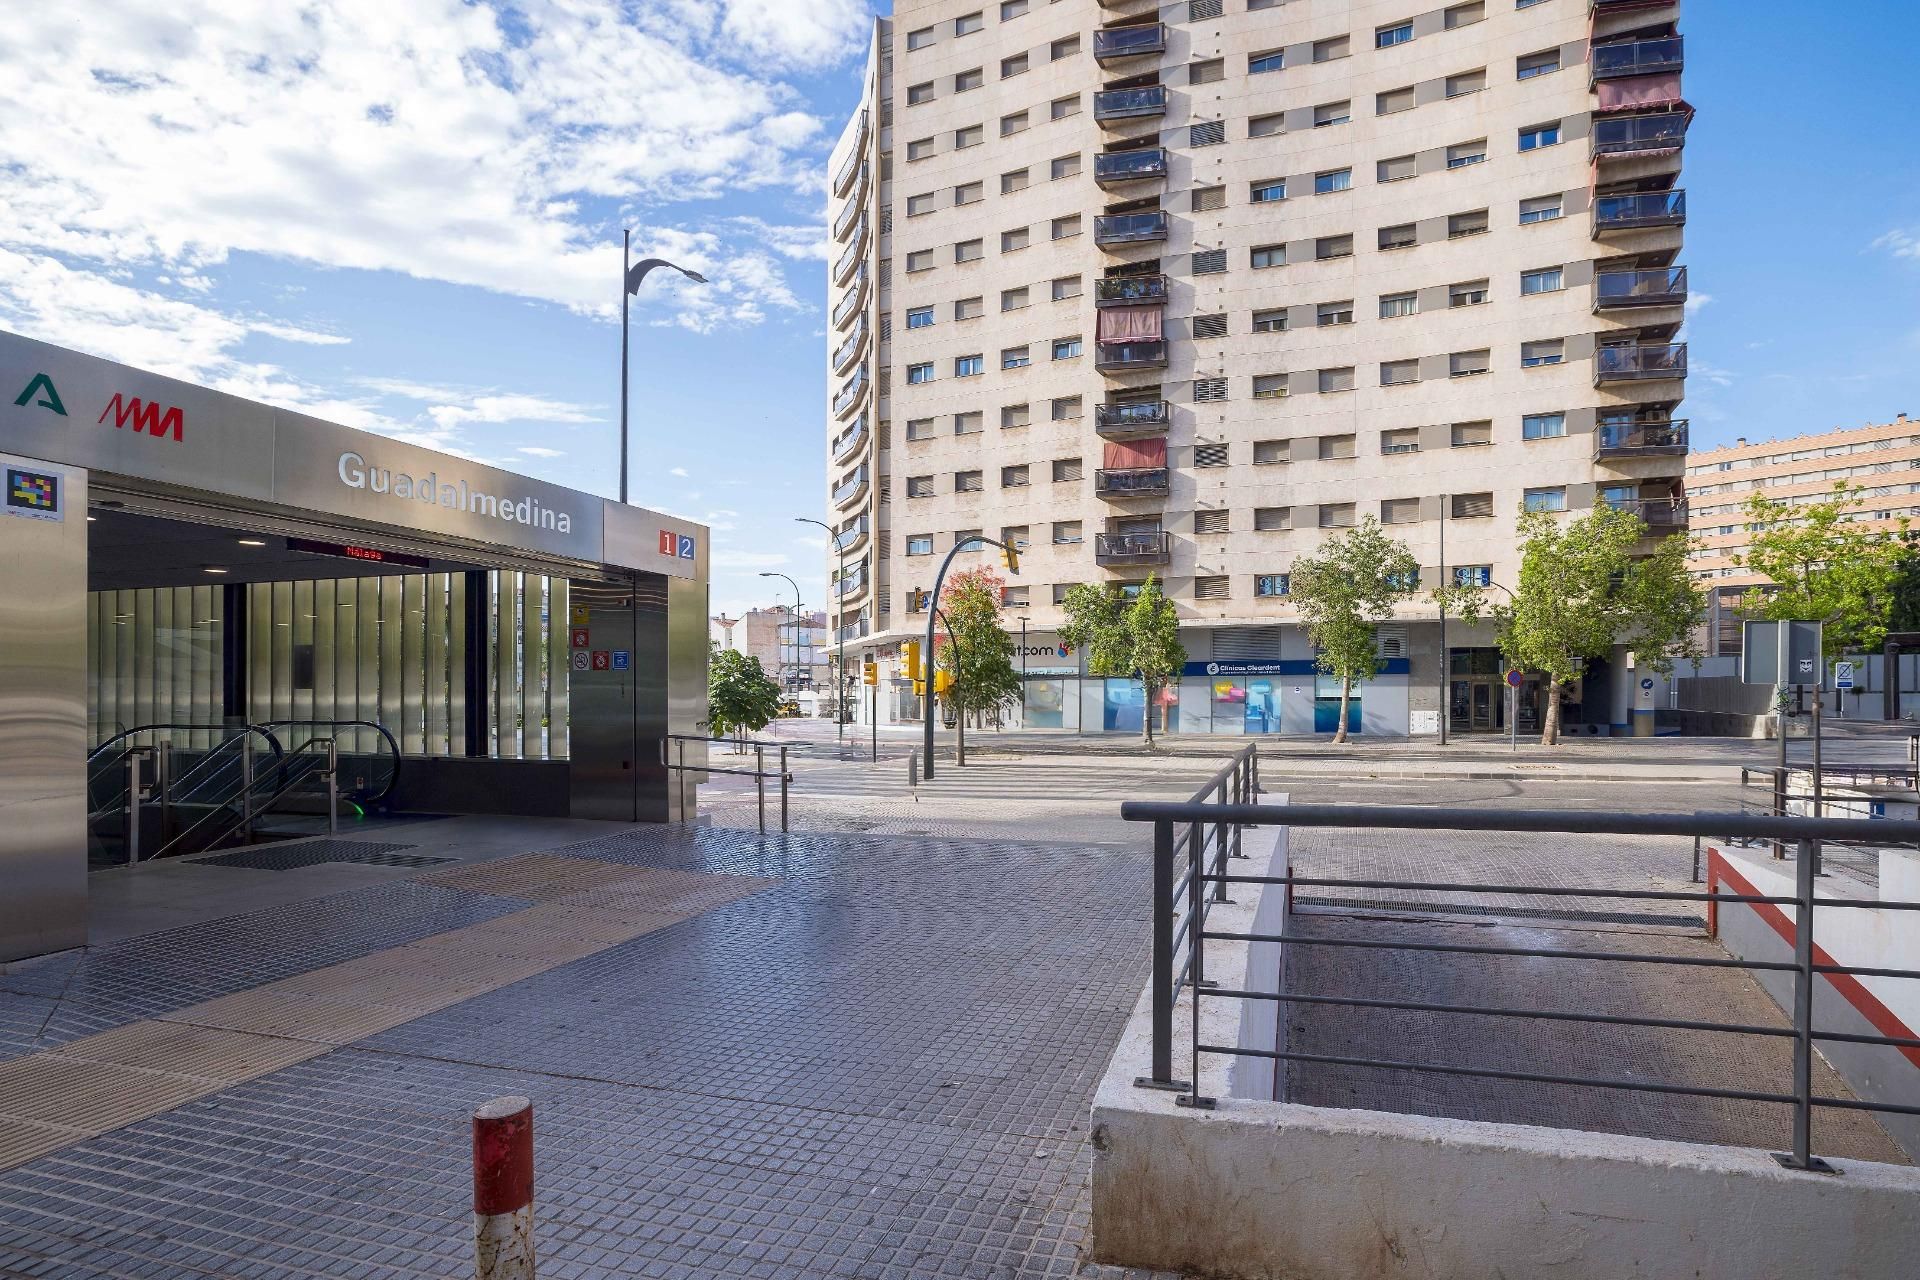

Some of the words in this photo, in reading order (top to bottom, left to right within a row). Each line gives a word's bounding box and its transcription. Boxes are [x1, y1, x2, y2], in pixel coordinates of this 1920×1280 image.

[337, 450, 571, 534] Guadalmedina
[664, 533, 672, 554] 1
[681, 538, 691, 558] 2
